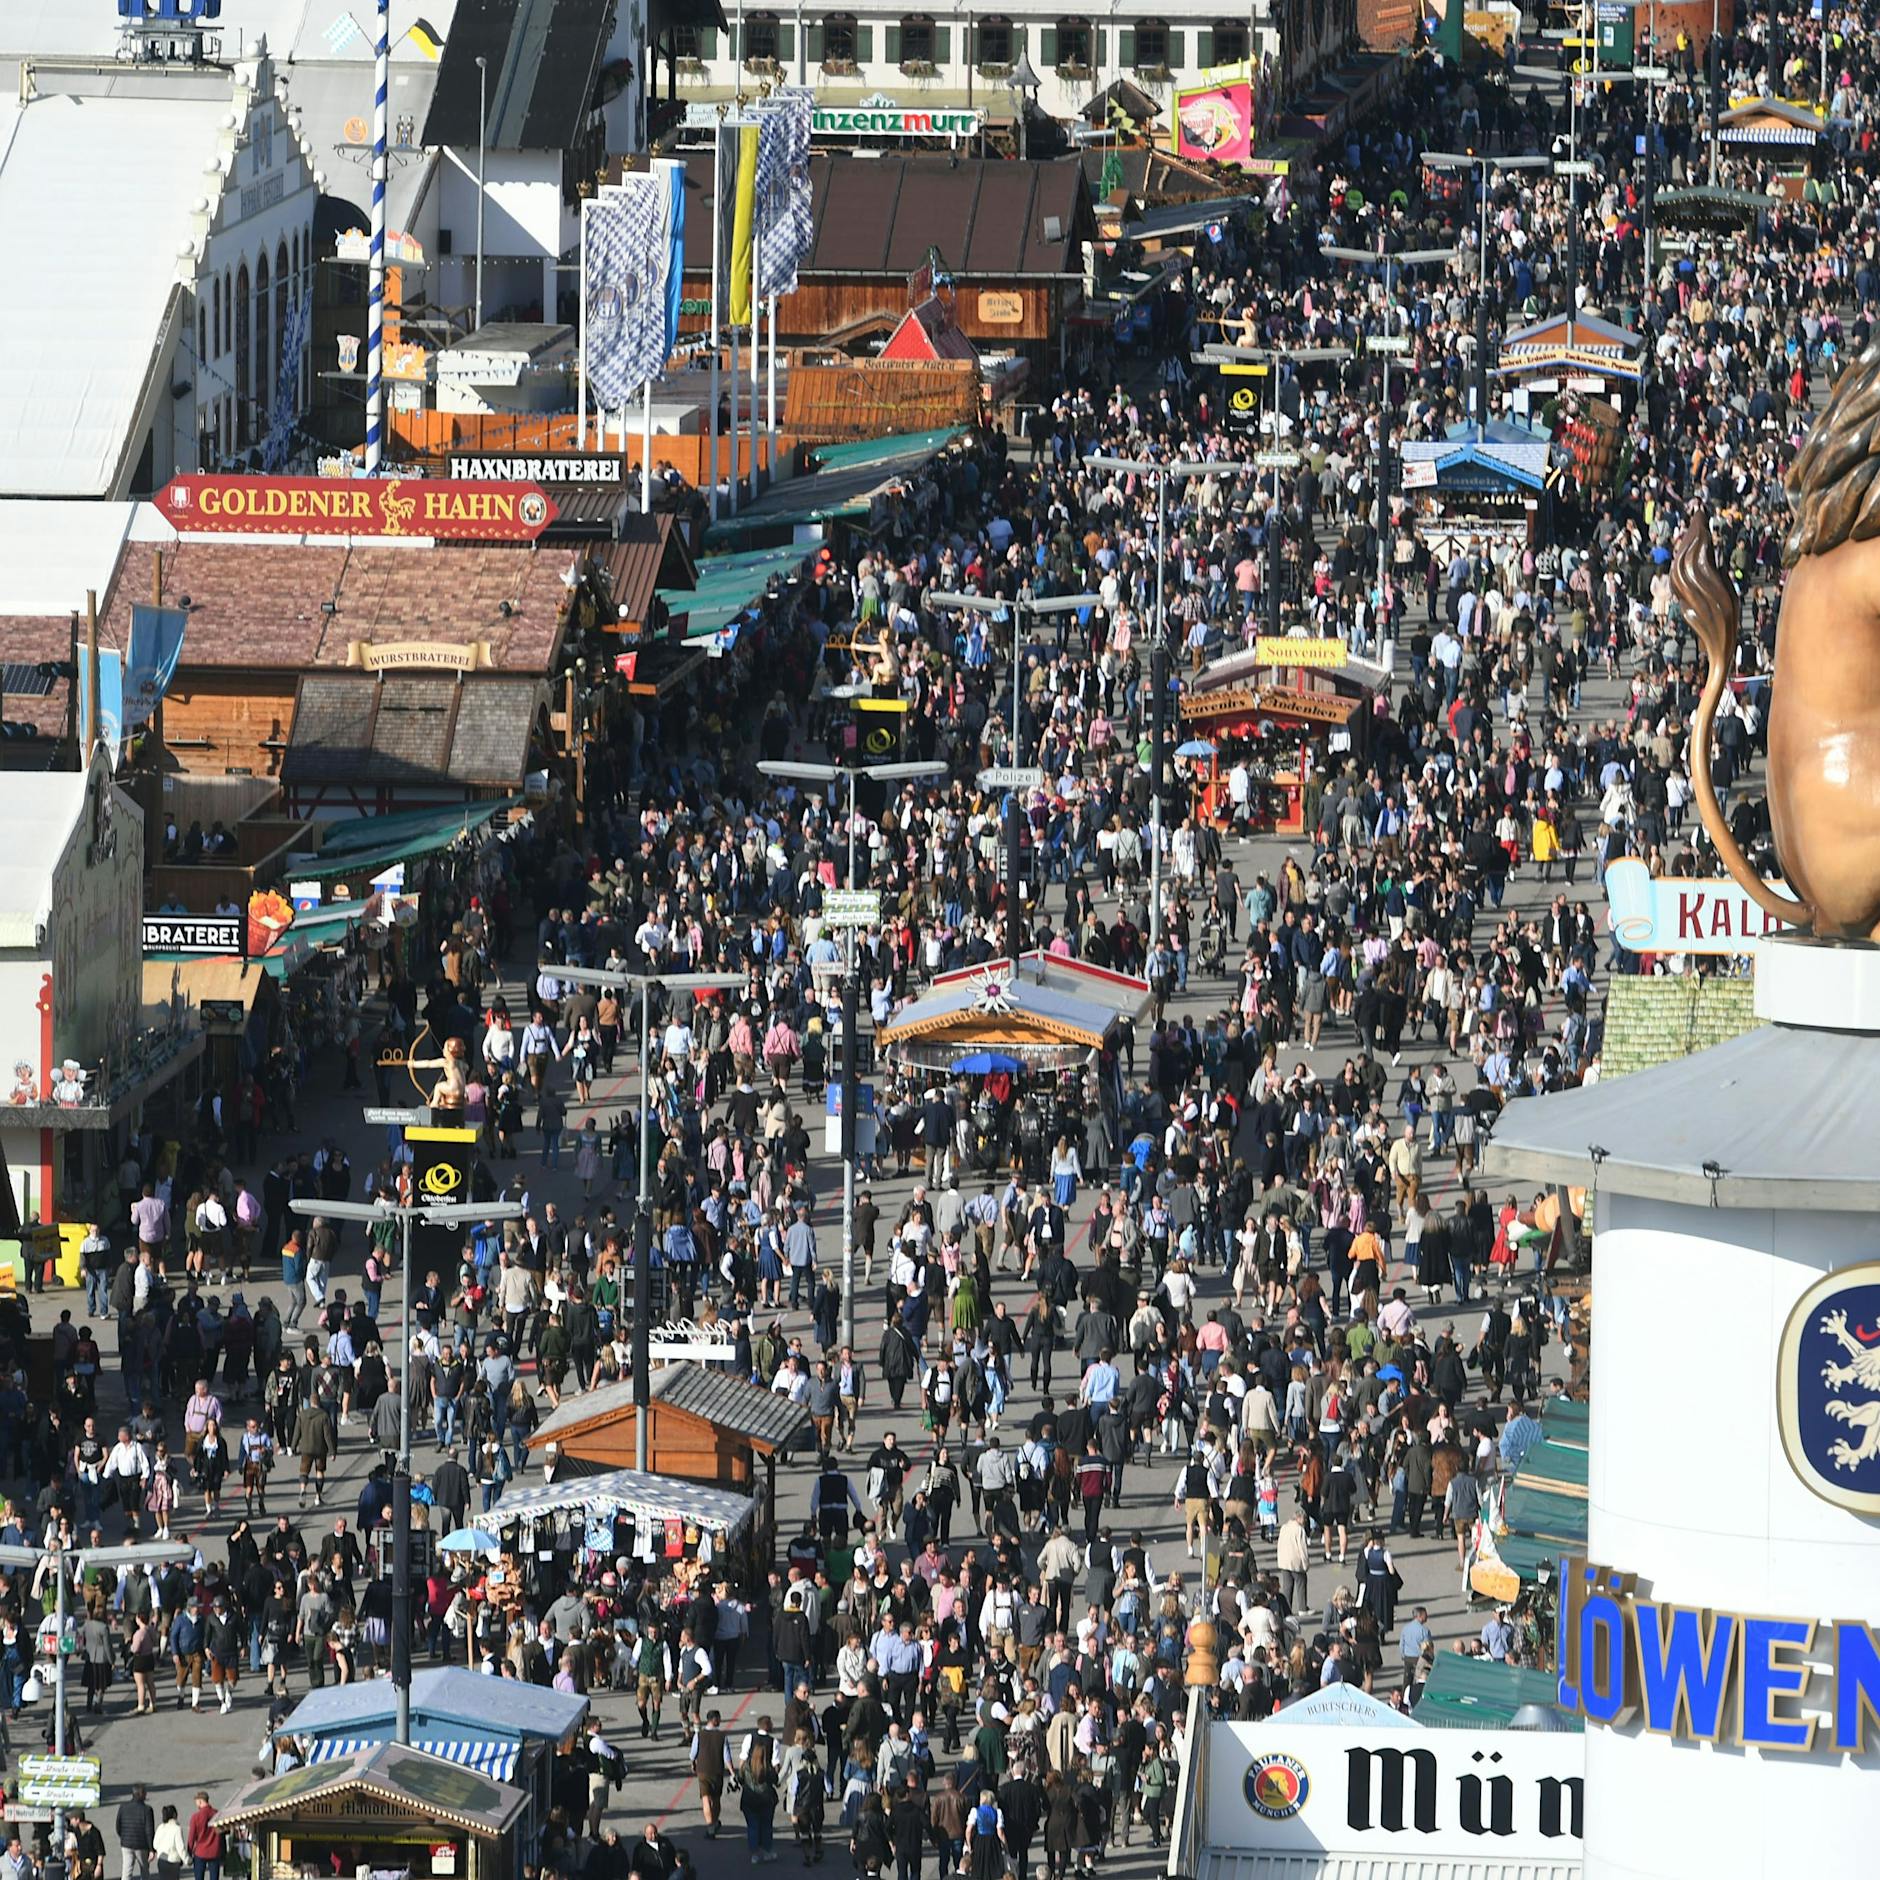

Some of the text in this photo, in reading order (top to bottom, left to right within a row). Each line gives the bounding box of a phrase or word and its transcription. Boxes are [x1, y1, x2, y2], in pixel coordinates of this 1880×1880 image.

[812, 108, 977, 133] inzenzmurr
[451, 457, 621, 482] HAXNBRATEREI
[199, 487, 373, 519] GOLDENER
[424, 492, 516, 522] HAHN
[369, 652, 471, 667] WURSTBRATEREI
[1267, 645, 1336, 659] Souvenirs
[1180, 698, 1338, 719] Souvenirs Andenken
[995, 771, 1036, 782] Polizei
[1557, 1552, 1880, 1753] LÖWEN
[1307, 1701, 1378, 1718] BURTSCHERS
[1248, 1753, 1307, 1780] PAULANER
[1252, 1800, 1302, 1818] MÜNCHEN
